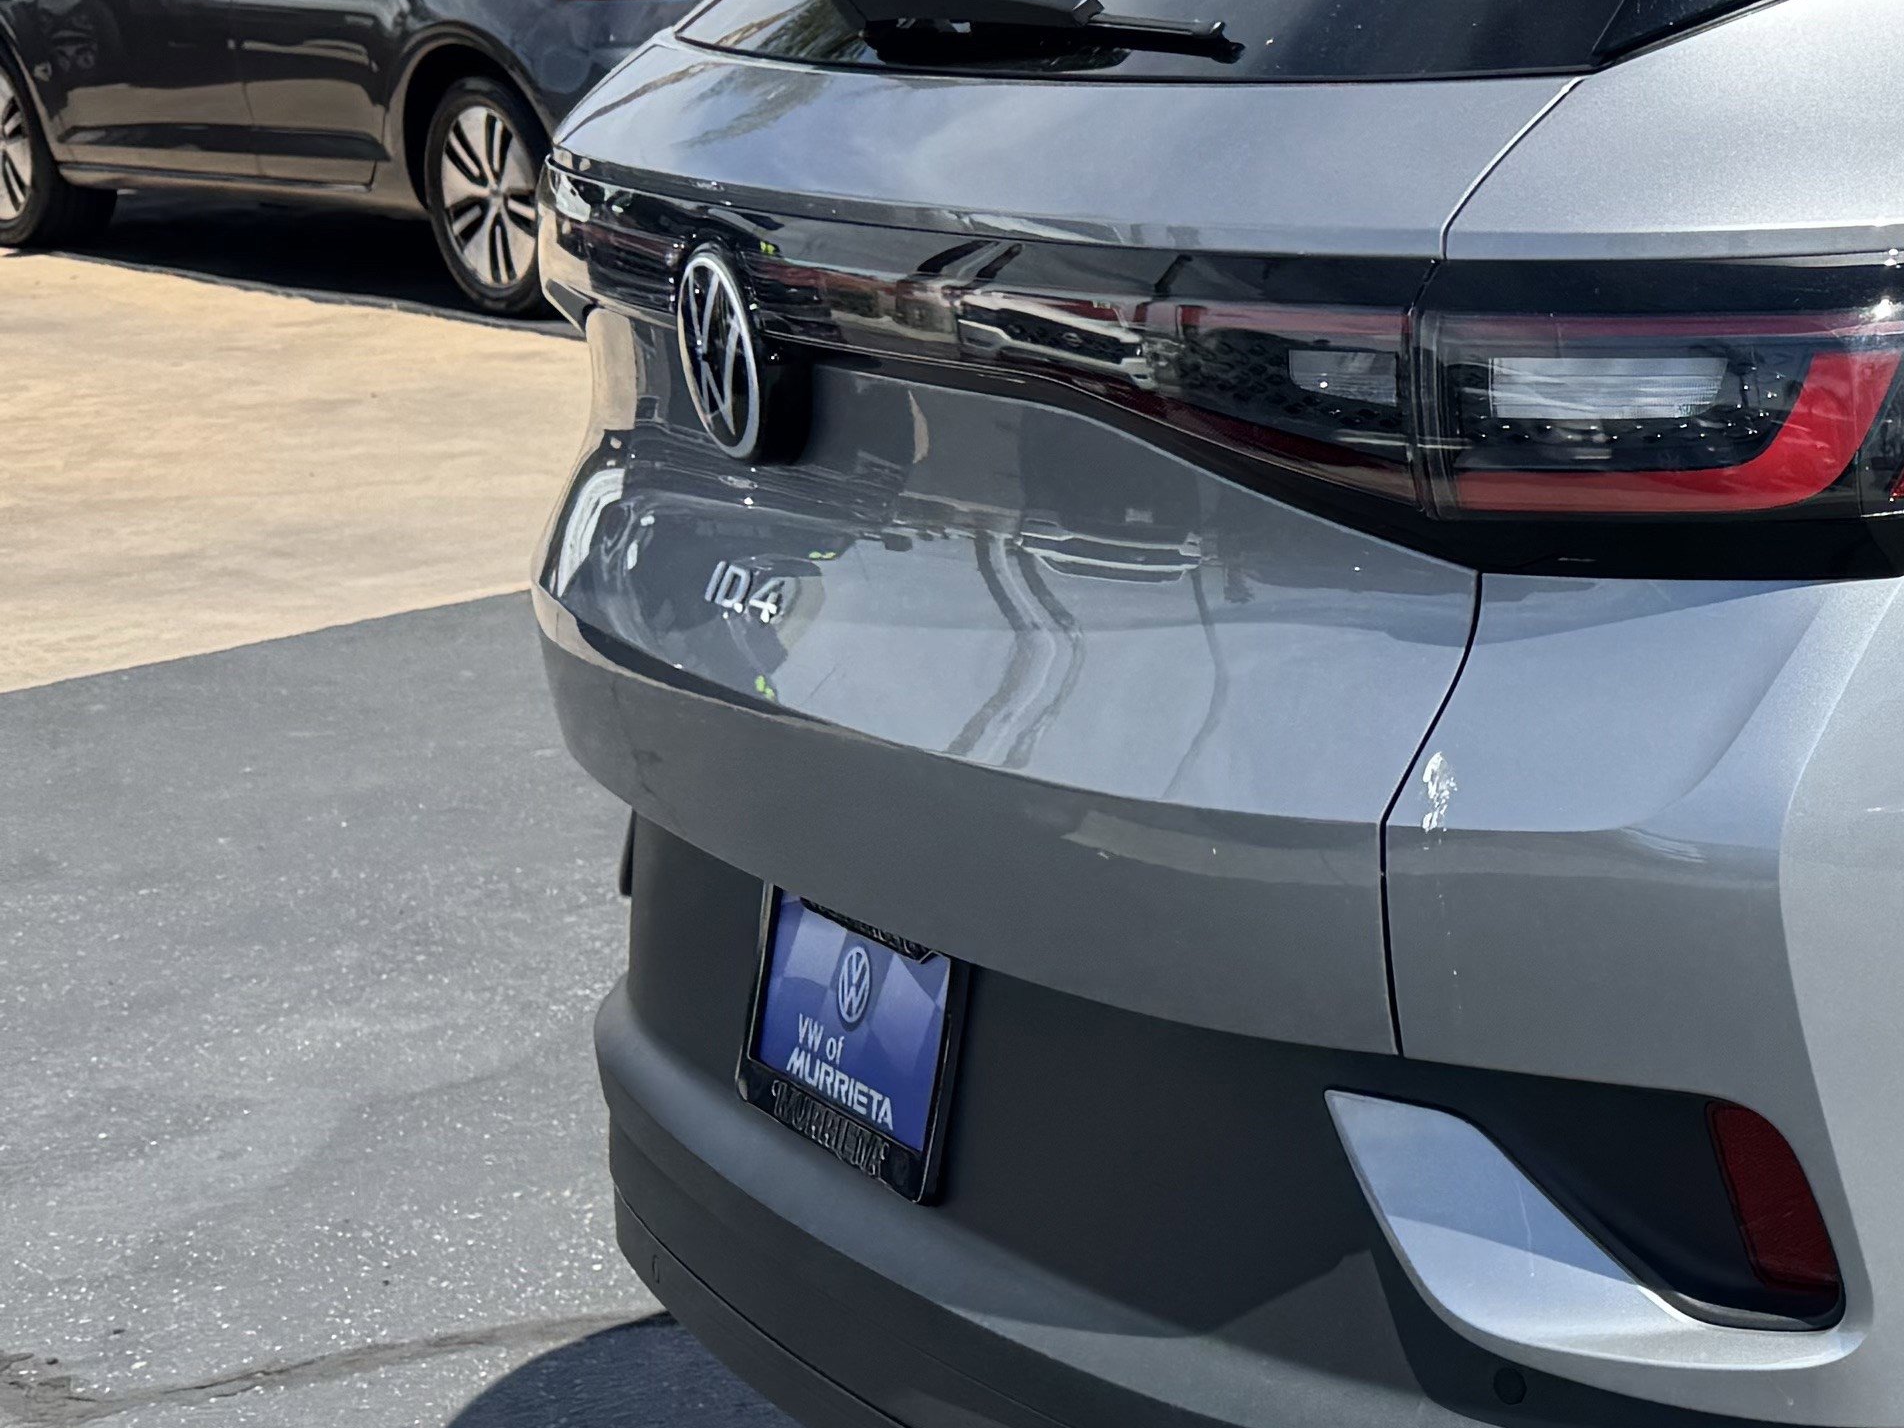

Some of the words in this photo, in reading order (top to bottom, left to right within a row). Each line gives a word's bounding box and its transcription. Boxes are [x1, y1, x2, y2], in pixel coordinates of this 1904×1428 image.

[798, 1013, 823, 1053] VW
[825, 1035, 845, 1061] of
[785, 1046, 894, 1131] MURRIETA
